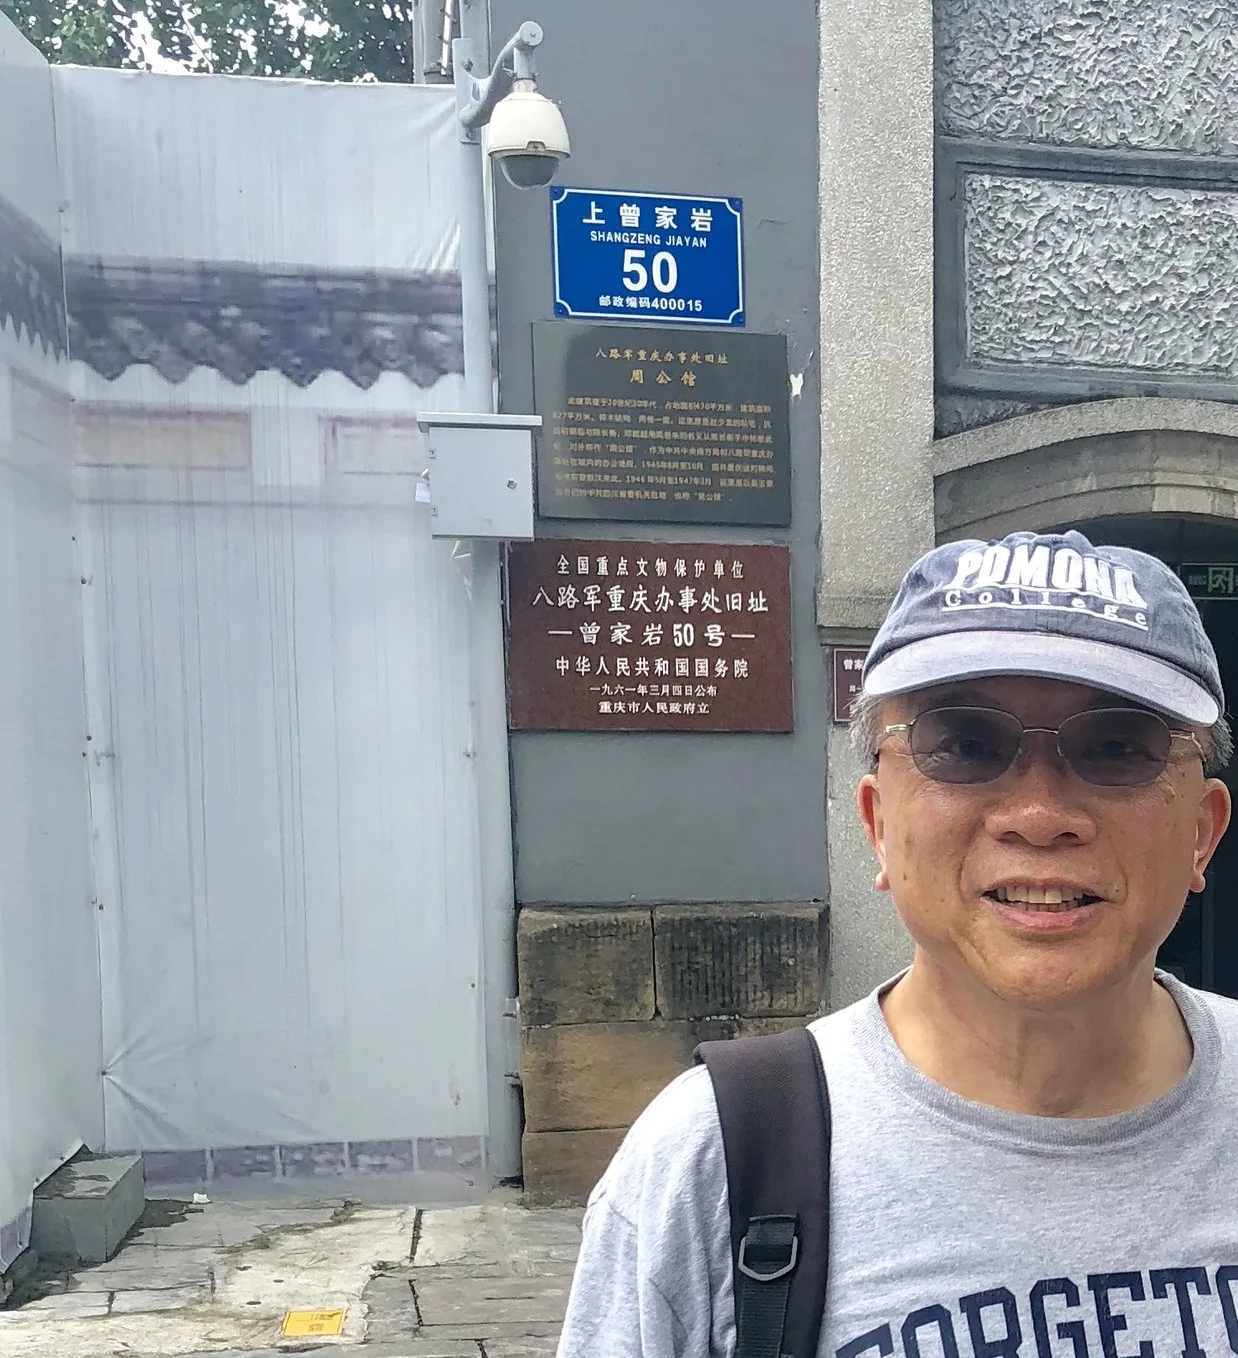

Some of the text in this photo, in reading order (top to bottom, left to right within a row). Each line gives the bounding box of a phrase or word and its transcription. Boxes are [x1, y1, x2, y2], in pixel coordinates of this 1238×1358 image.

[582, 201, 713, 232] 上曾家岩
[590, 231, 707, 248] SHANGZENG JIAYAN
[622, 248, 678, 294] 50
[595, 348, 729, 365] 八路军重庆办事处旧址
[629, 368, 697, 387] 周公馆
[556, 553, 745, 579] 全国重点文物保护单位
[946, 544, 1148, 608] POMONA
[532, 584, 769, 615] 八路军重庆办事处旧址
[945, 588, 1148, 626] College
[555, 655, 749, 679] 中华人民共和国国务院
[589, 684, 718, 698] 一九六一年三月四日公布
[598, 701, 710, 715] 重庆市人民政府立
